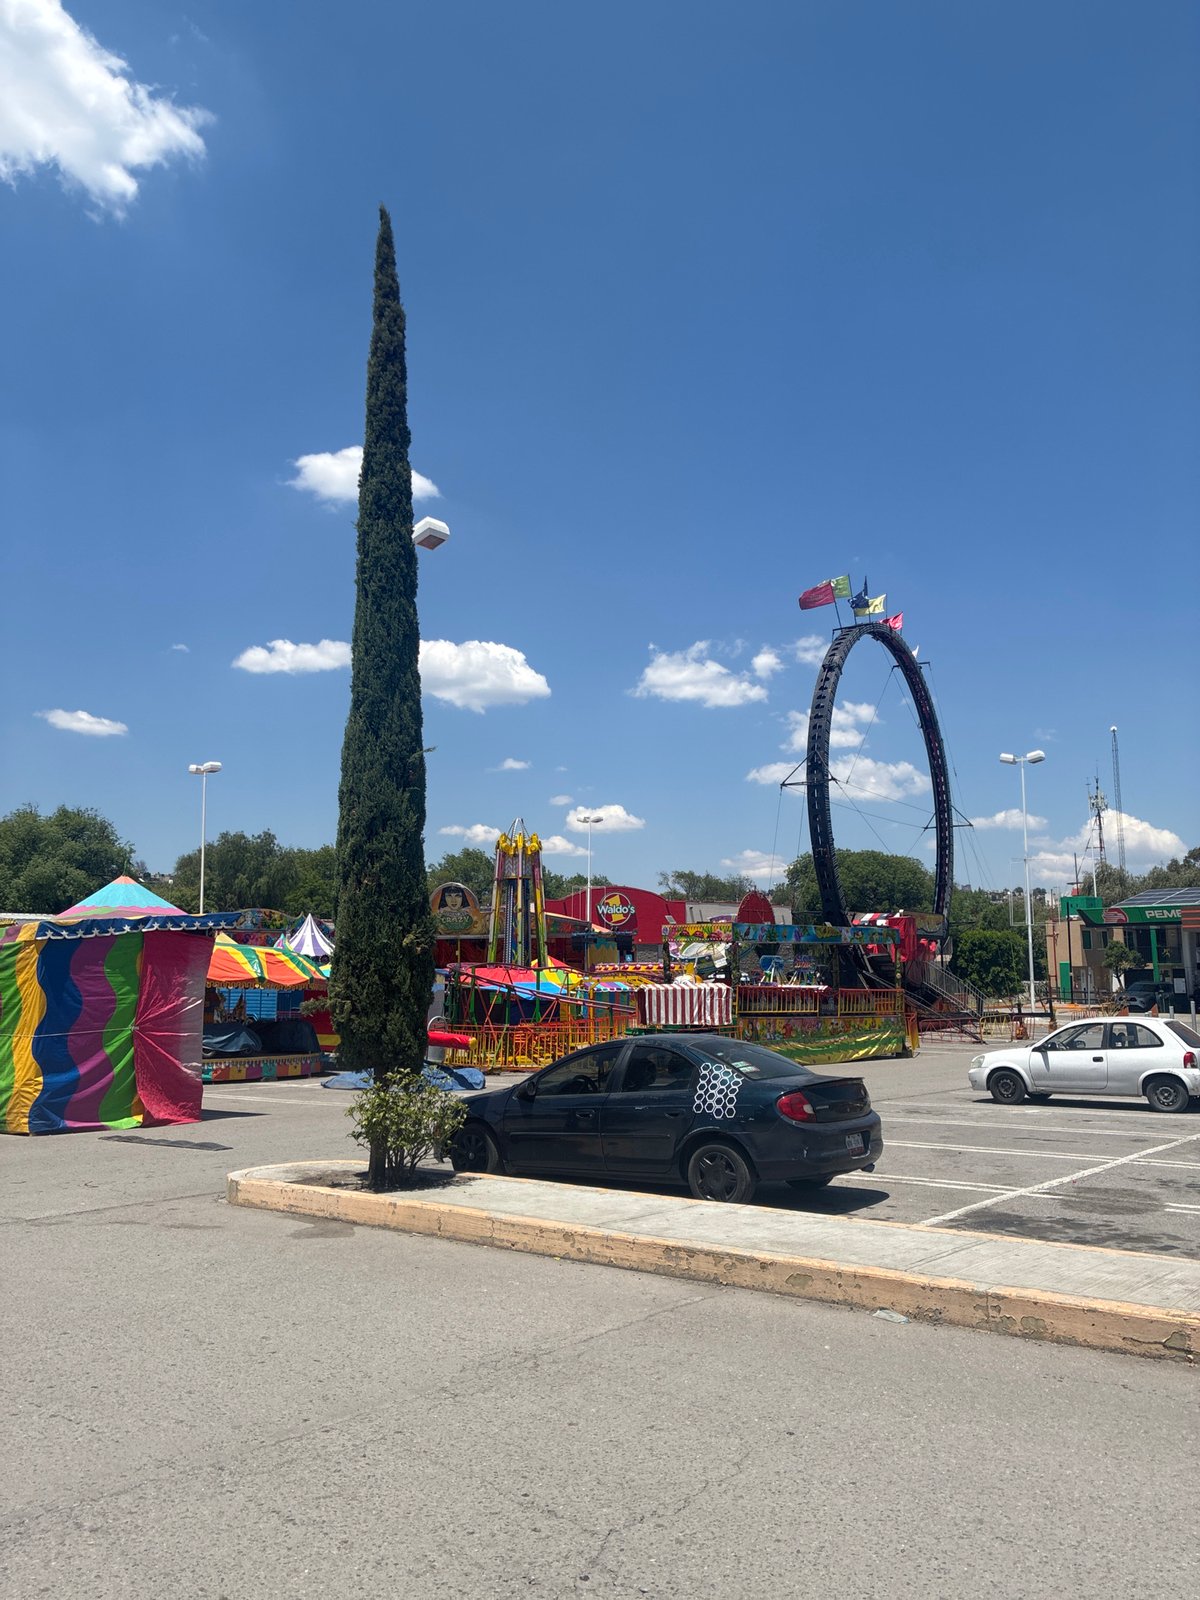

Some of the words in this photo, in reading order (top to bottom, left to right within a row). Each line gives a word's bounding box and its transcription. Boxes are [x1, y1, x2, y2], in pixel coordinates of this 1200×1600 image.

[597, 904, 636, 914] Waldo's
[1144, 909, 1182, 919] PEME
[441, 916, 470, 924] CRAZY
